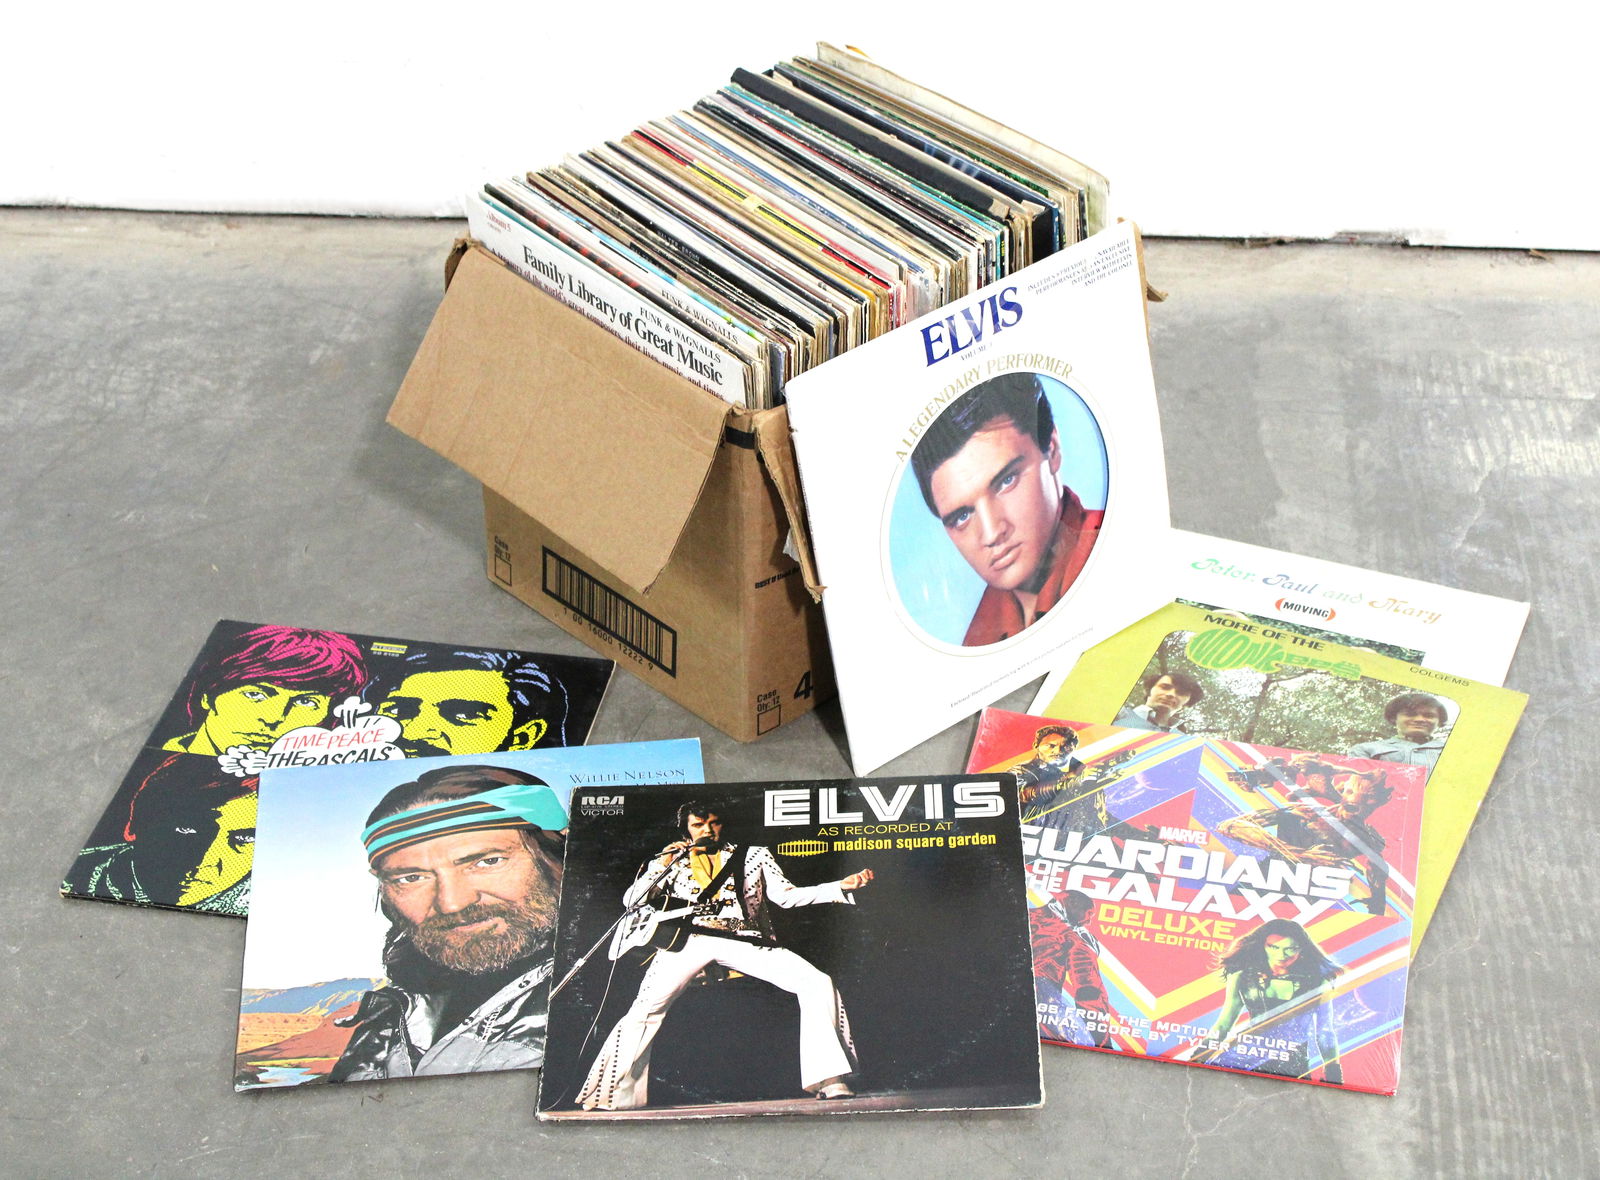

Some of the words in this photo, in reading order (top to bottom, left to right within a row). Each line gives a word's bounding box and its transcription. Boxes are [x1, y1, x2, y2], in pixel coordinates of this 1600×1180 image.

[522, 244, 565, 290] Family
[567, 273, 617, 323] Library
[619, 312, 633, 330] of
[635, 317, 674, 358] Great
[677, 341, 722, 386] Music
[661, 289, 684, 309] FUNK
[685, 304, 691, 314] &
[693, 309, 739, 345] WAGNALLS
[920, 286, 1023, 367] ELVIS
[640, 307, 663, 328] FUNK
[665, 323, 671, 332] &
[673, 327, 721, 363] WAGNALLS
[895, 450, 907, 462] A
[902, 366, 981, 449] LEGENDARY
[986, 353, 1073, 380] PERFORMER
[1262, 573, 1319, 595] Paul
[1322, 587, 1363, 604] and
[1368, 598, 1442, 625] Mary
[1282, 602, 1331, 618] MOVING
[563, 607, 568, 615] 1
[572, 614, 583, 625] 00
[588, 623, 613, 645] 16000
[618, 642, 643, 665] 12222
[1203, 614, 1258, 634] MORE
[1262, 629, 1288, 640] OF
[1291, 635, 1326, 651] THE
[1188, 629, 1361, 679] MONKEES
[794, 670, 814, 699] 4
[1409, 666, 1470, 687] COLGEMS
[757, 690, 777, 703] Case
[268, 750, 307, 768] THE
[581, 795, 625, 805] RCA
[764, 781, 1006, 826] ELVIS
[817, 827, 839, 836] AS
[844, 823, 930, 835] RECORDED
[934, 821, 954, 831] AT
[833, 837, 892, 851] madison
[896, 835, 944, 850] square
[948, 832, 997, 848] garden
[1158, 826, 1210, 845] MARVEL
[1031, 859, 1071, 877] OF
[1066, 864, 1337, 925] GALAXY
[1097, 903, 1236, 940] DELUXE
[1099, 924, 1149, 943] VINYL
[1150, 932, 1225, 953] EDITION
[1065, 1007, 1111, 1022] FROM
[1118, 1015, 1151, 1028] THE
[1156, 1020, 1220, 1039] MOTION
[1086, 1022, 1143, 1038] SCORE
[1148, 1031, 1170, 1042] BY
[1176, 1034, 1230, 1052] TYLER
[1236, 1045, 1290, 1061] BATES
